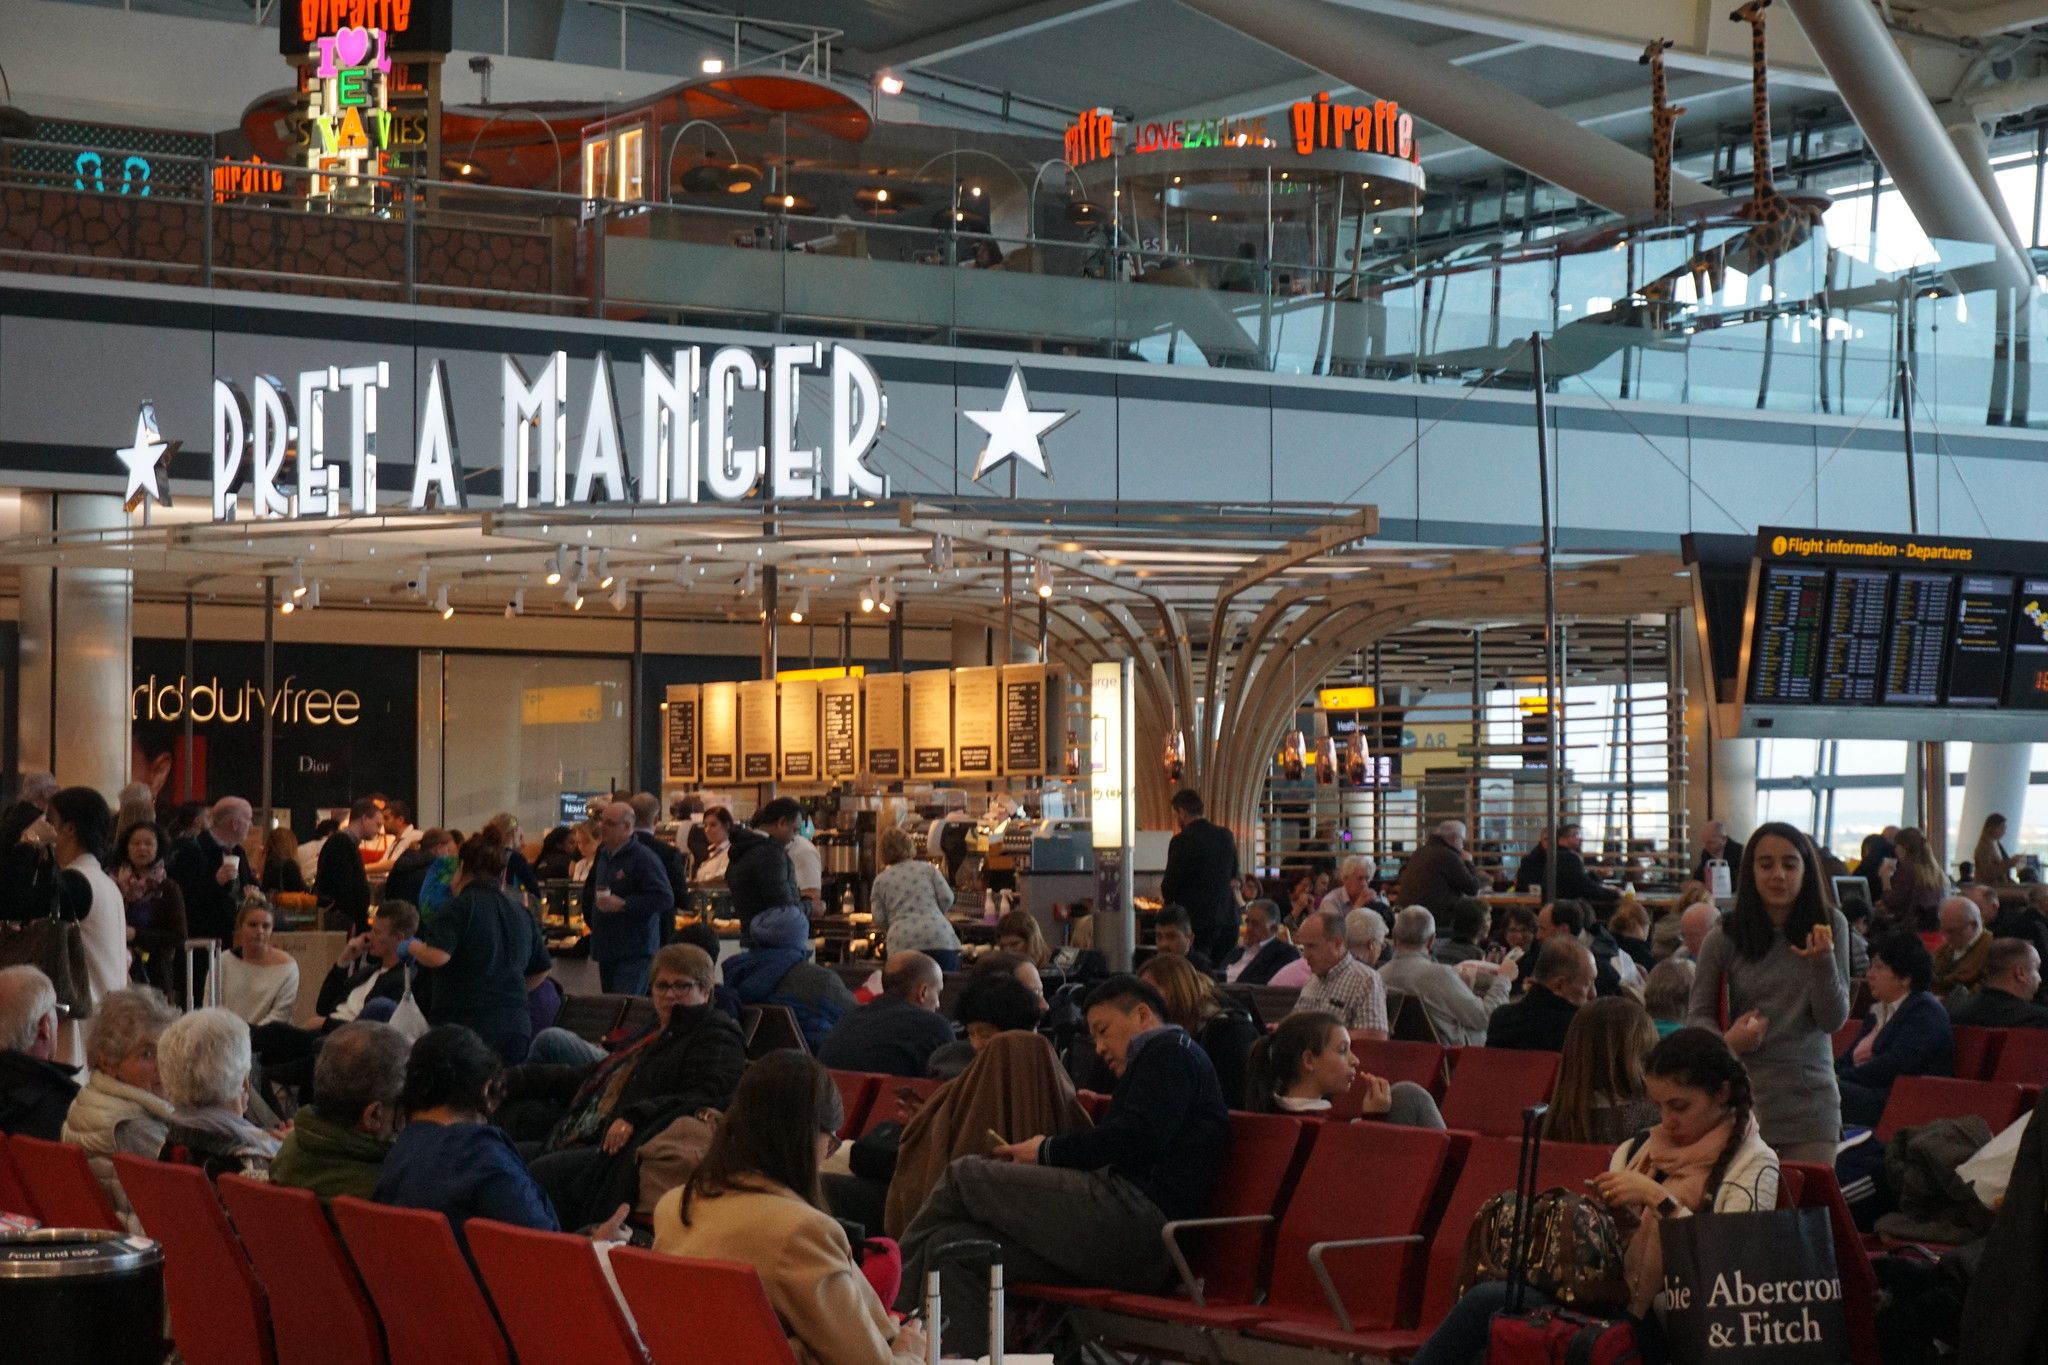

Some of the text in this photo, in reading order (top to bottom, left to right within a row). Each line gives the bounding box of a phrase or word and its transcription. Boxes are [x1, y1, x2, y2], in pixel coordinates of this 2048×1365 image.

[1290, 90, 1413, 159] giraffe
[213, 341, 891, 520] PRET A MANGER
[1789, 537, 1824, 556] Flight
[1826, 539, 1897, 557] information
[1907, 543, 1973, 561] Departures
[1424, 732, 1446, 748] A8
[299, 756, 330, 773] Dior
[1708, 1307, 1823, 1348] & Fitch
